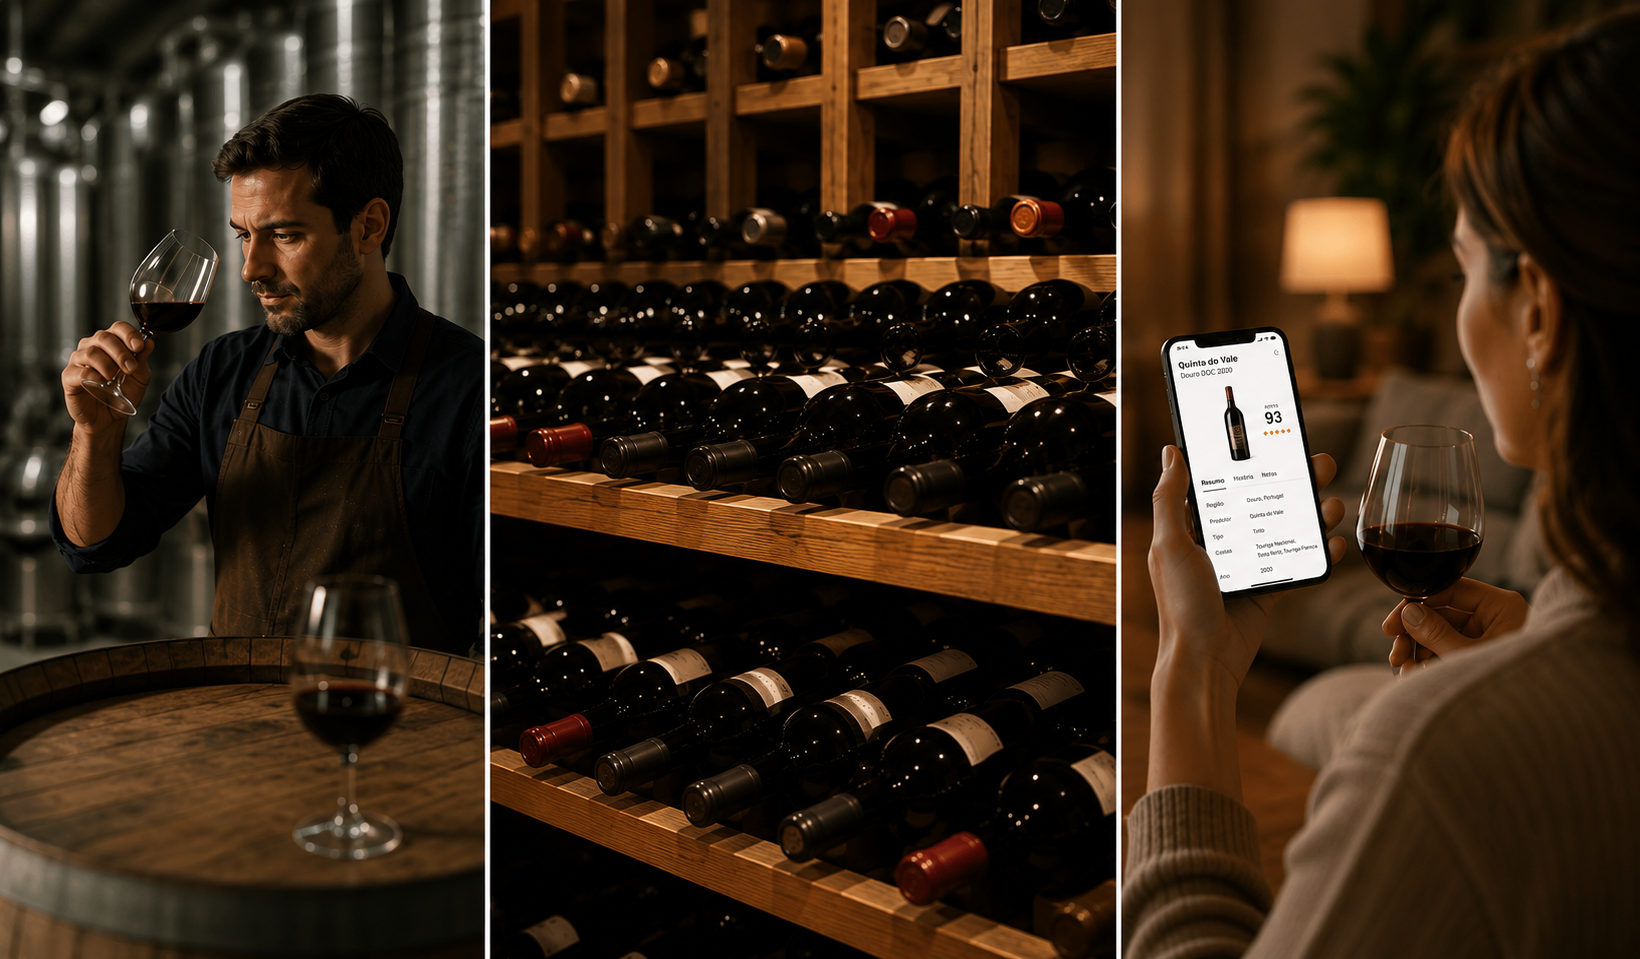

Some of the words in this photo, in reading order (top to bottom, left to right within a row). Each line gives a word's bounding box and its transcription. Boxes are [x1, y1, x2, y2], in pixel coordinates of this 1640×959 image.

[1178, 359, 1206, 370] Quinta
[1208, 357, 1219, 366] do
[1220, 355, 1238, 363] Vale
[1201, 369, 1216, 377] DOC
[1264, 410, 1283, 425] 93
